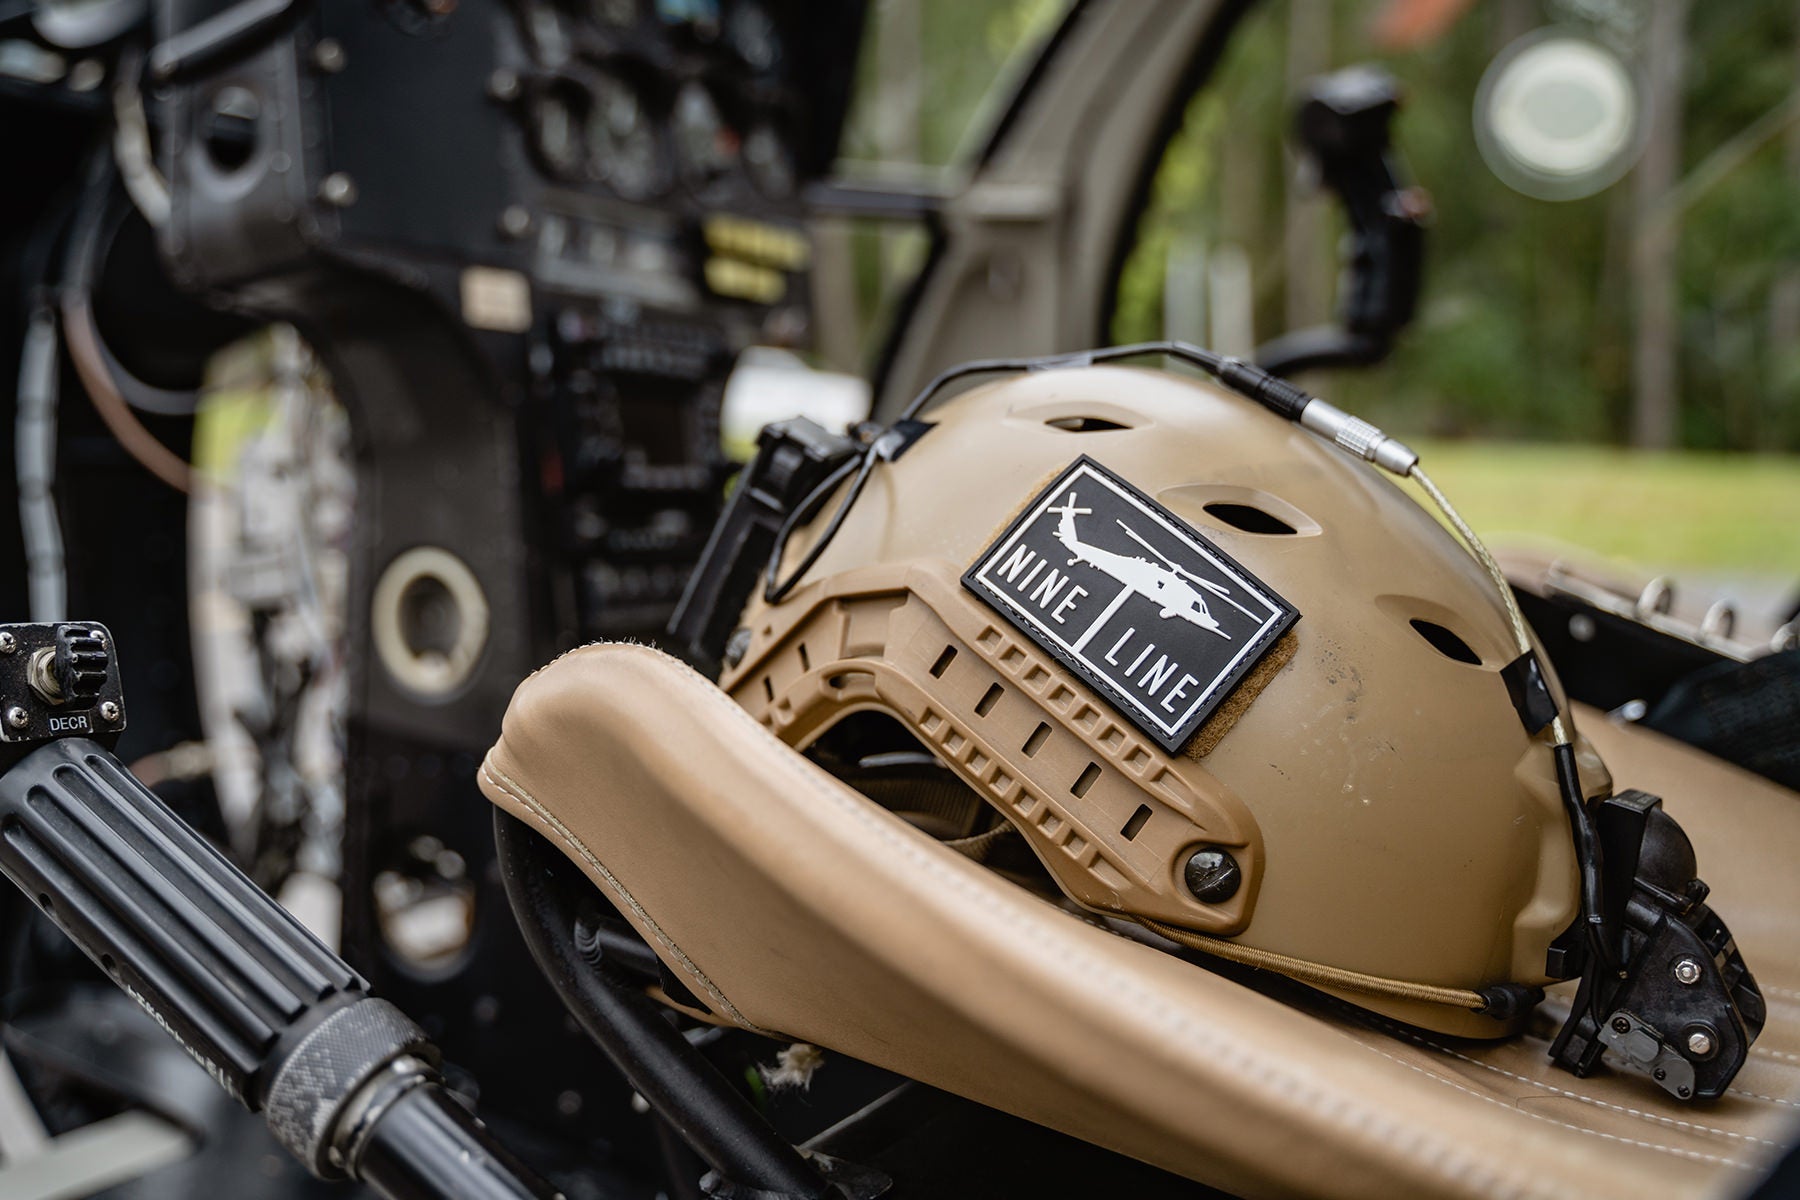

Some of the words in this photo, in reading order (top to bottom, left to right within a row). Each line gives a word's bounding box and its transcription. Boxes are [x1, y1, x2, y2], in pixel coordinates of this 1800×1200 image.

[997, 544, 1088, 624] NINE
[1105, 628, 1199, 713] LINE
[49, 715, 88, 731] DECR
